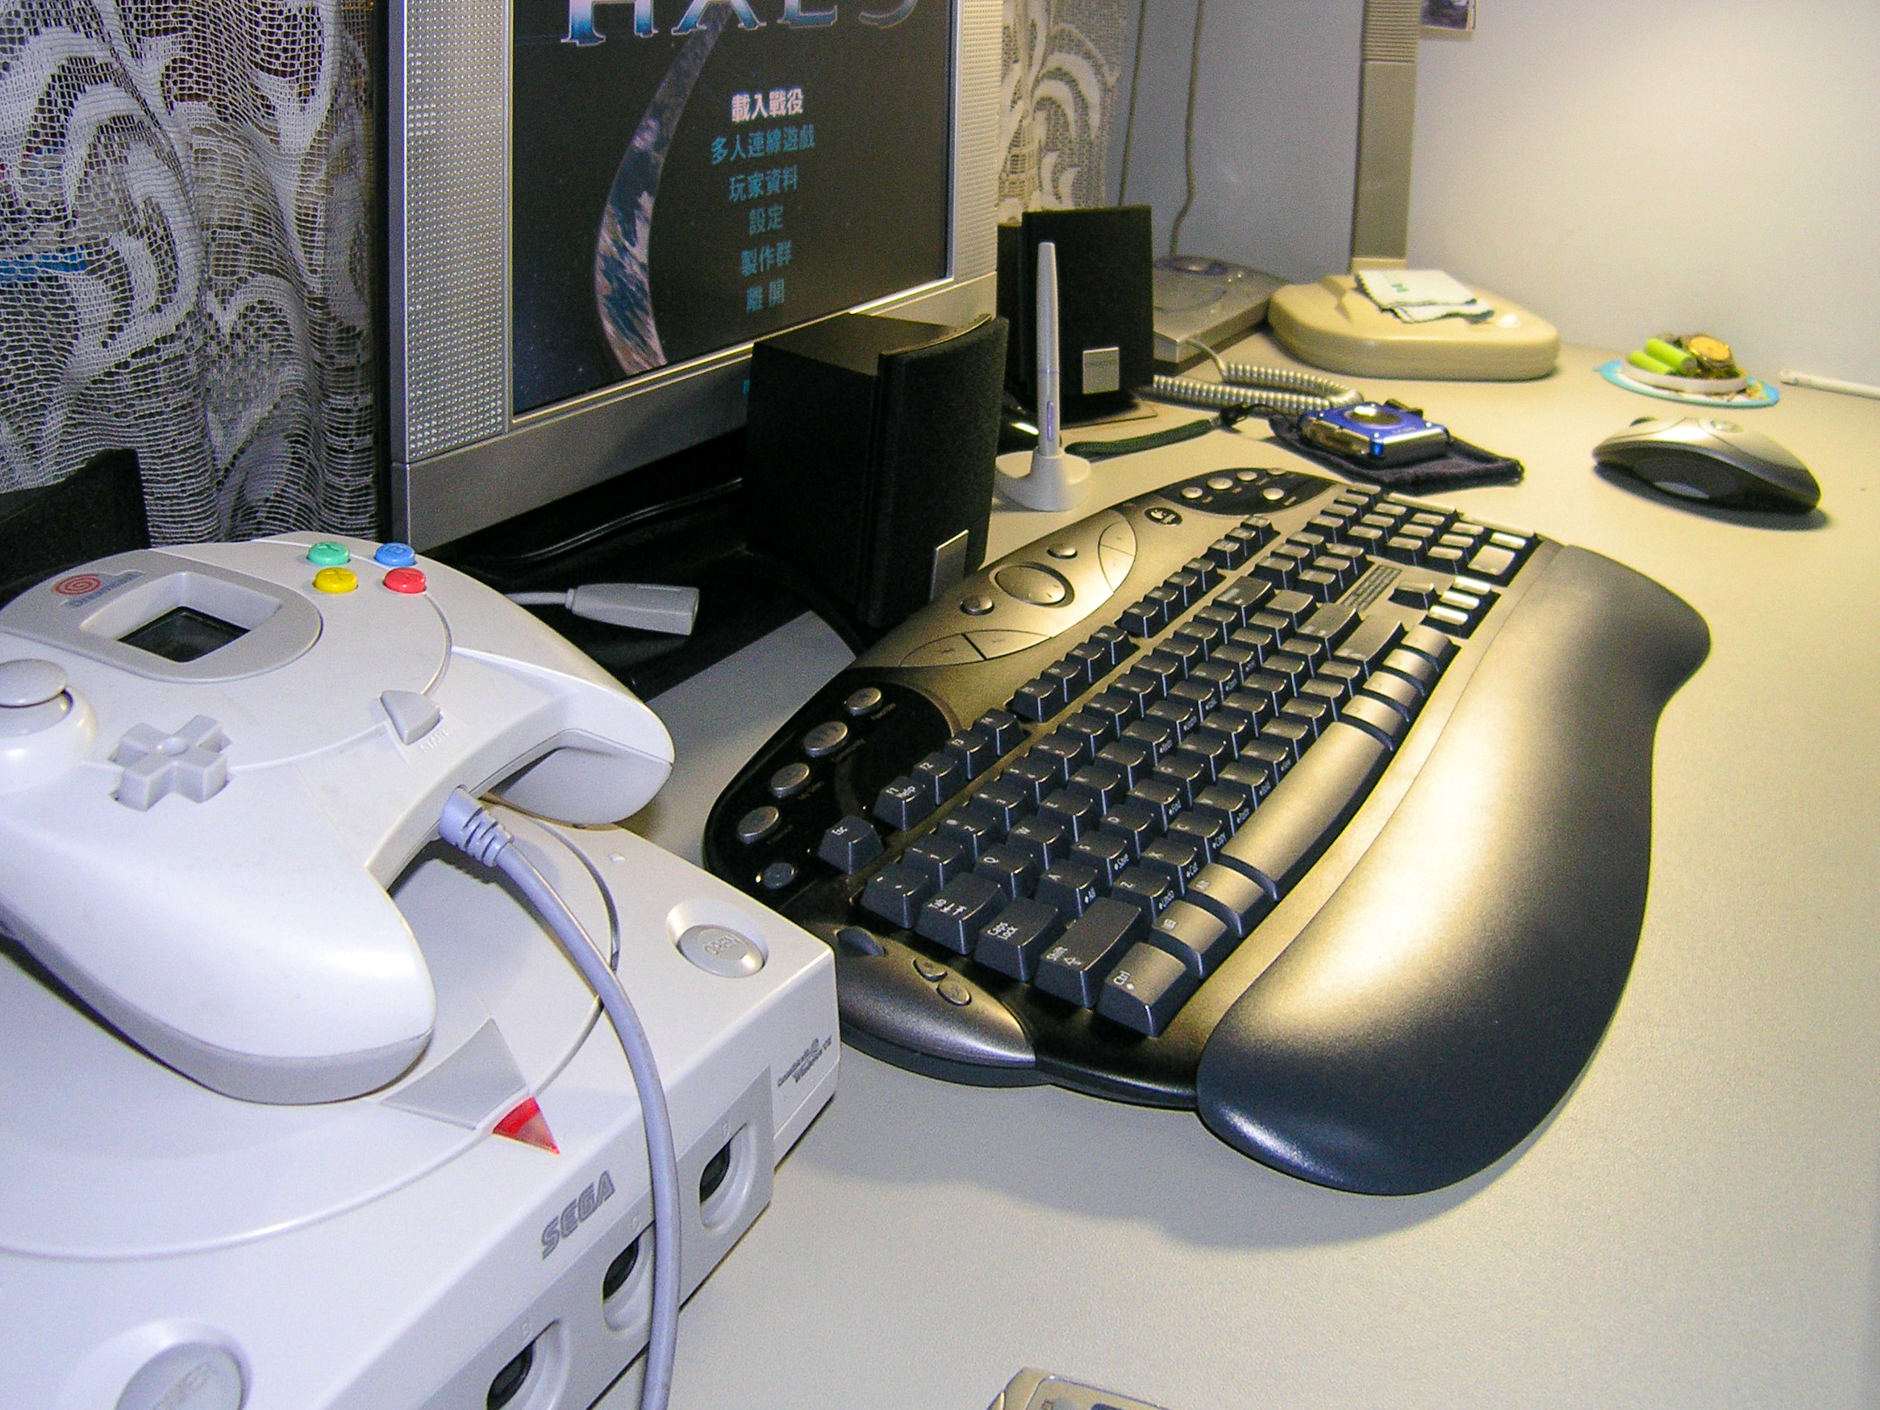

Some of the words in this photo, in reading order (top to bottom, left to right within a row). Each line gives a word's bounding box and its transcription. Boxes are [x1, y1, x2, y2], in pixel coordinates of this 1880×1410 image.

[731, 87, 803, 122] 載入戰役
[729, 165, 797, 202] 玩家資料
[748, 204, 783, 235] 設定
[741, 241, 792, 277] 製作群
[541, 1170, 616, 1260] SEGA
